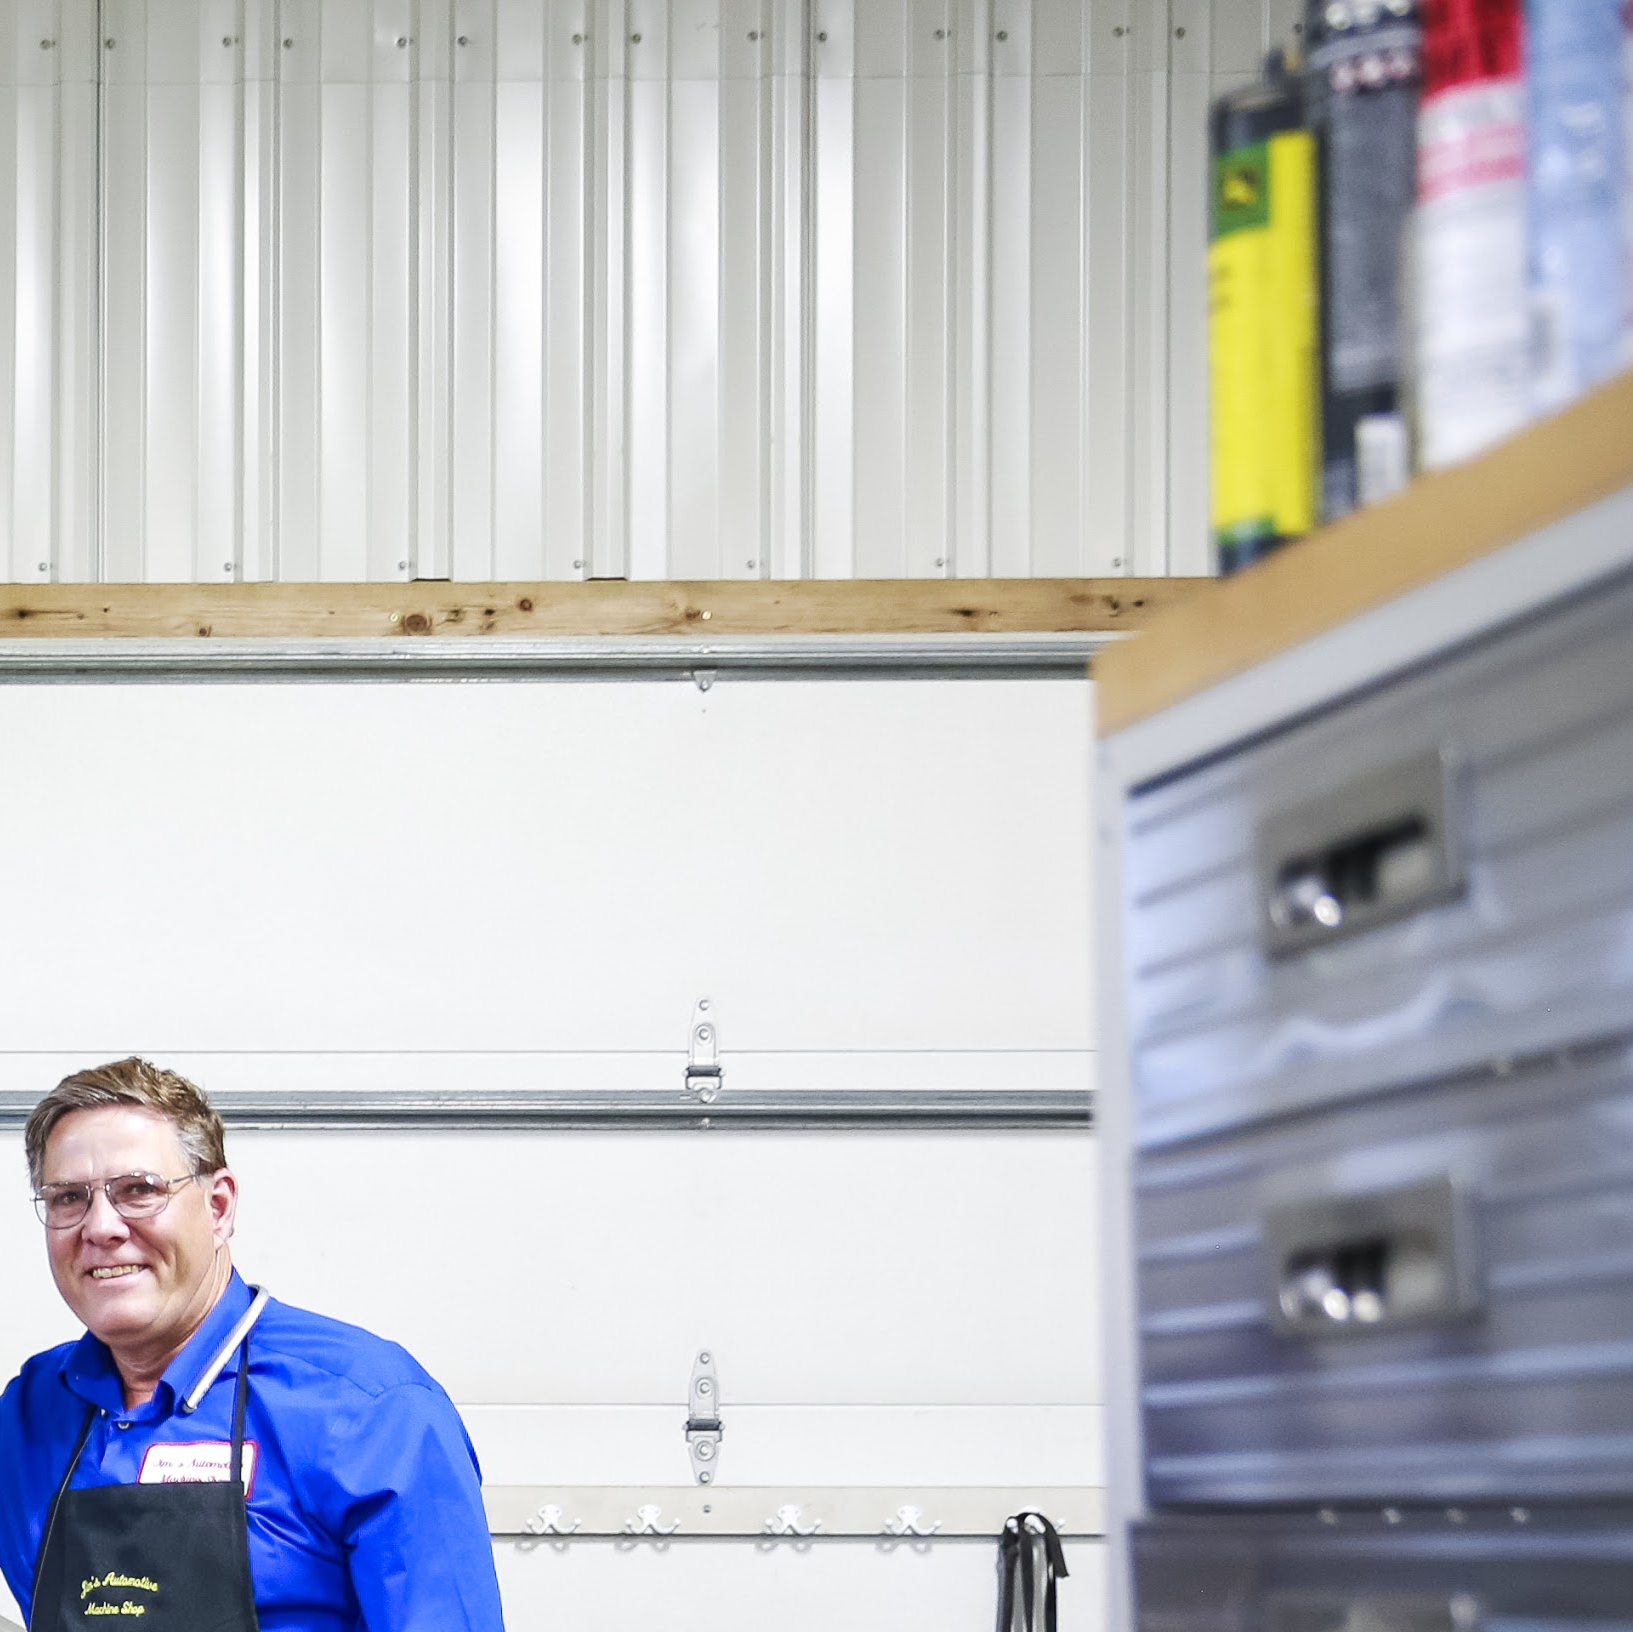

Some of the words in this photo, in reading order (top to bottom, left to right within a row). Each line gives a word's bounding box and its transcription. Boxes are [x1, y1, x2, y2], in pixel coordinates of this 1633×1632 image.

[102, 1571, 159, 1592] Automotive
[84, 1602, 120, 1616] Machine
[121, 1600, 145, 1617] Shop
